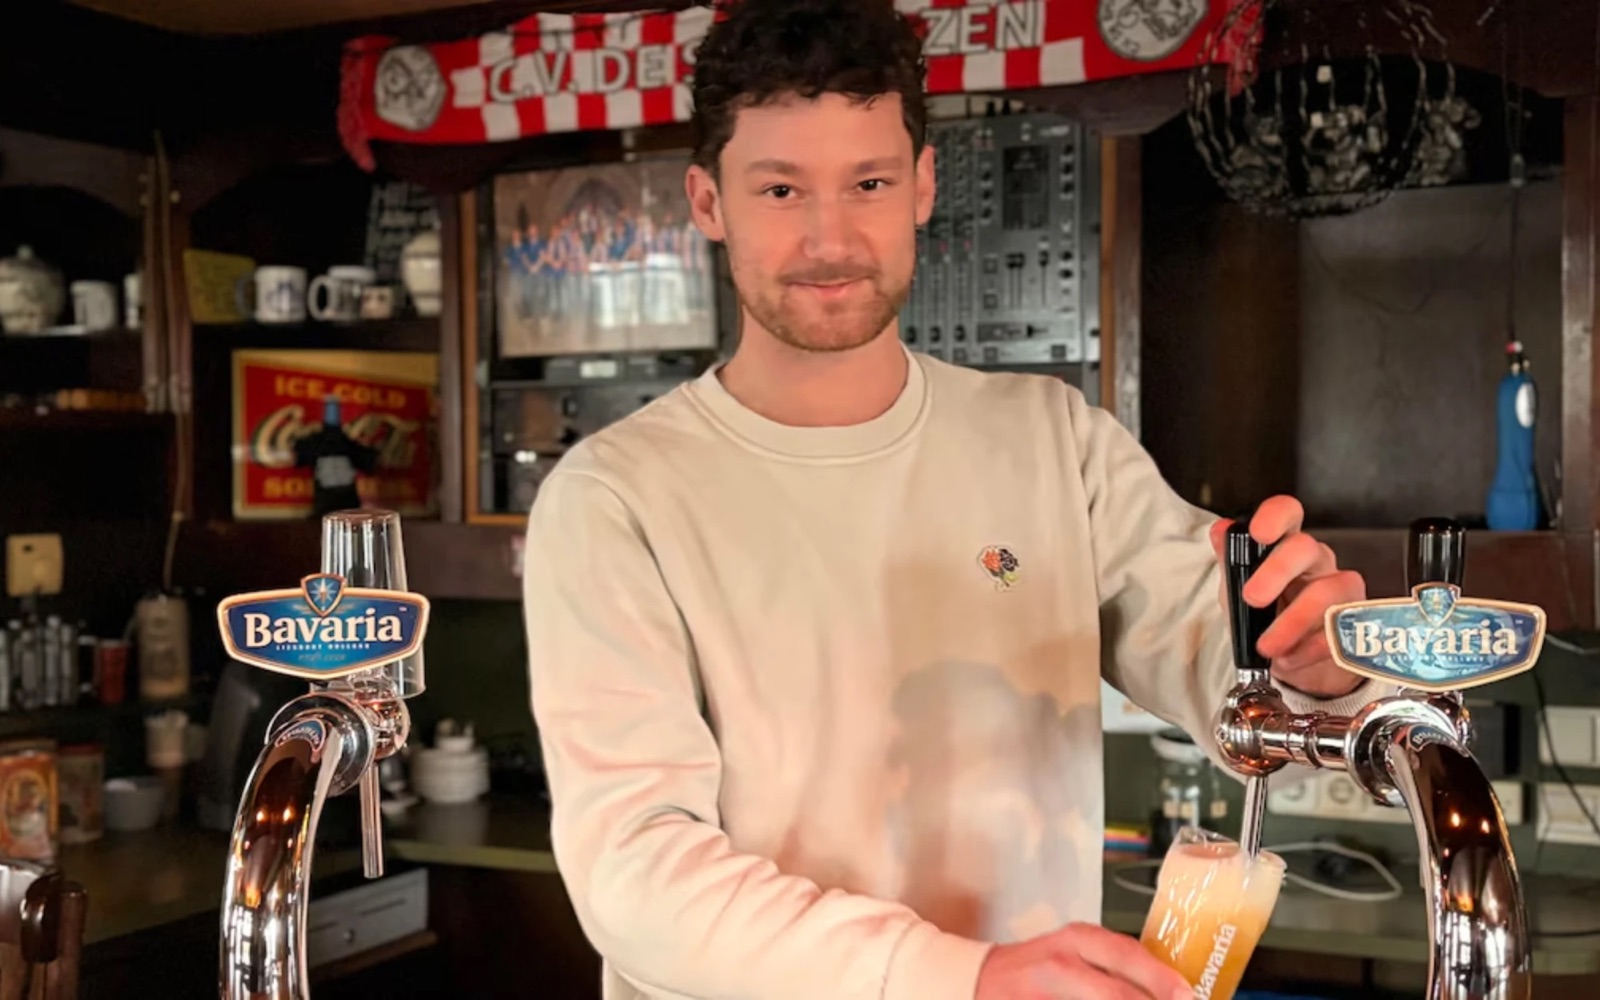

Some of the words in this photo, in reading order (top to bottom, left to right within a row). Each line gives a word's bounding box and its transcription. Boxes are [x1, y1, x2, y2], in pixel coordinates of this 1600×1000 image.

[920, 0, 1045, 55] ZEN
[274, 374, 325, 399] ICE
[332, 383, 406, 408] COLD
[243, 607, 403, 647] Bavaria
[1353, 618, 1519, 657] Bavaria
